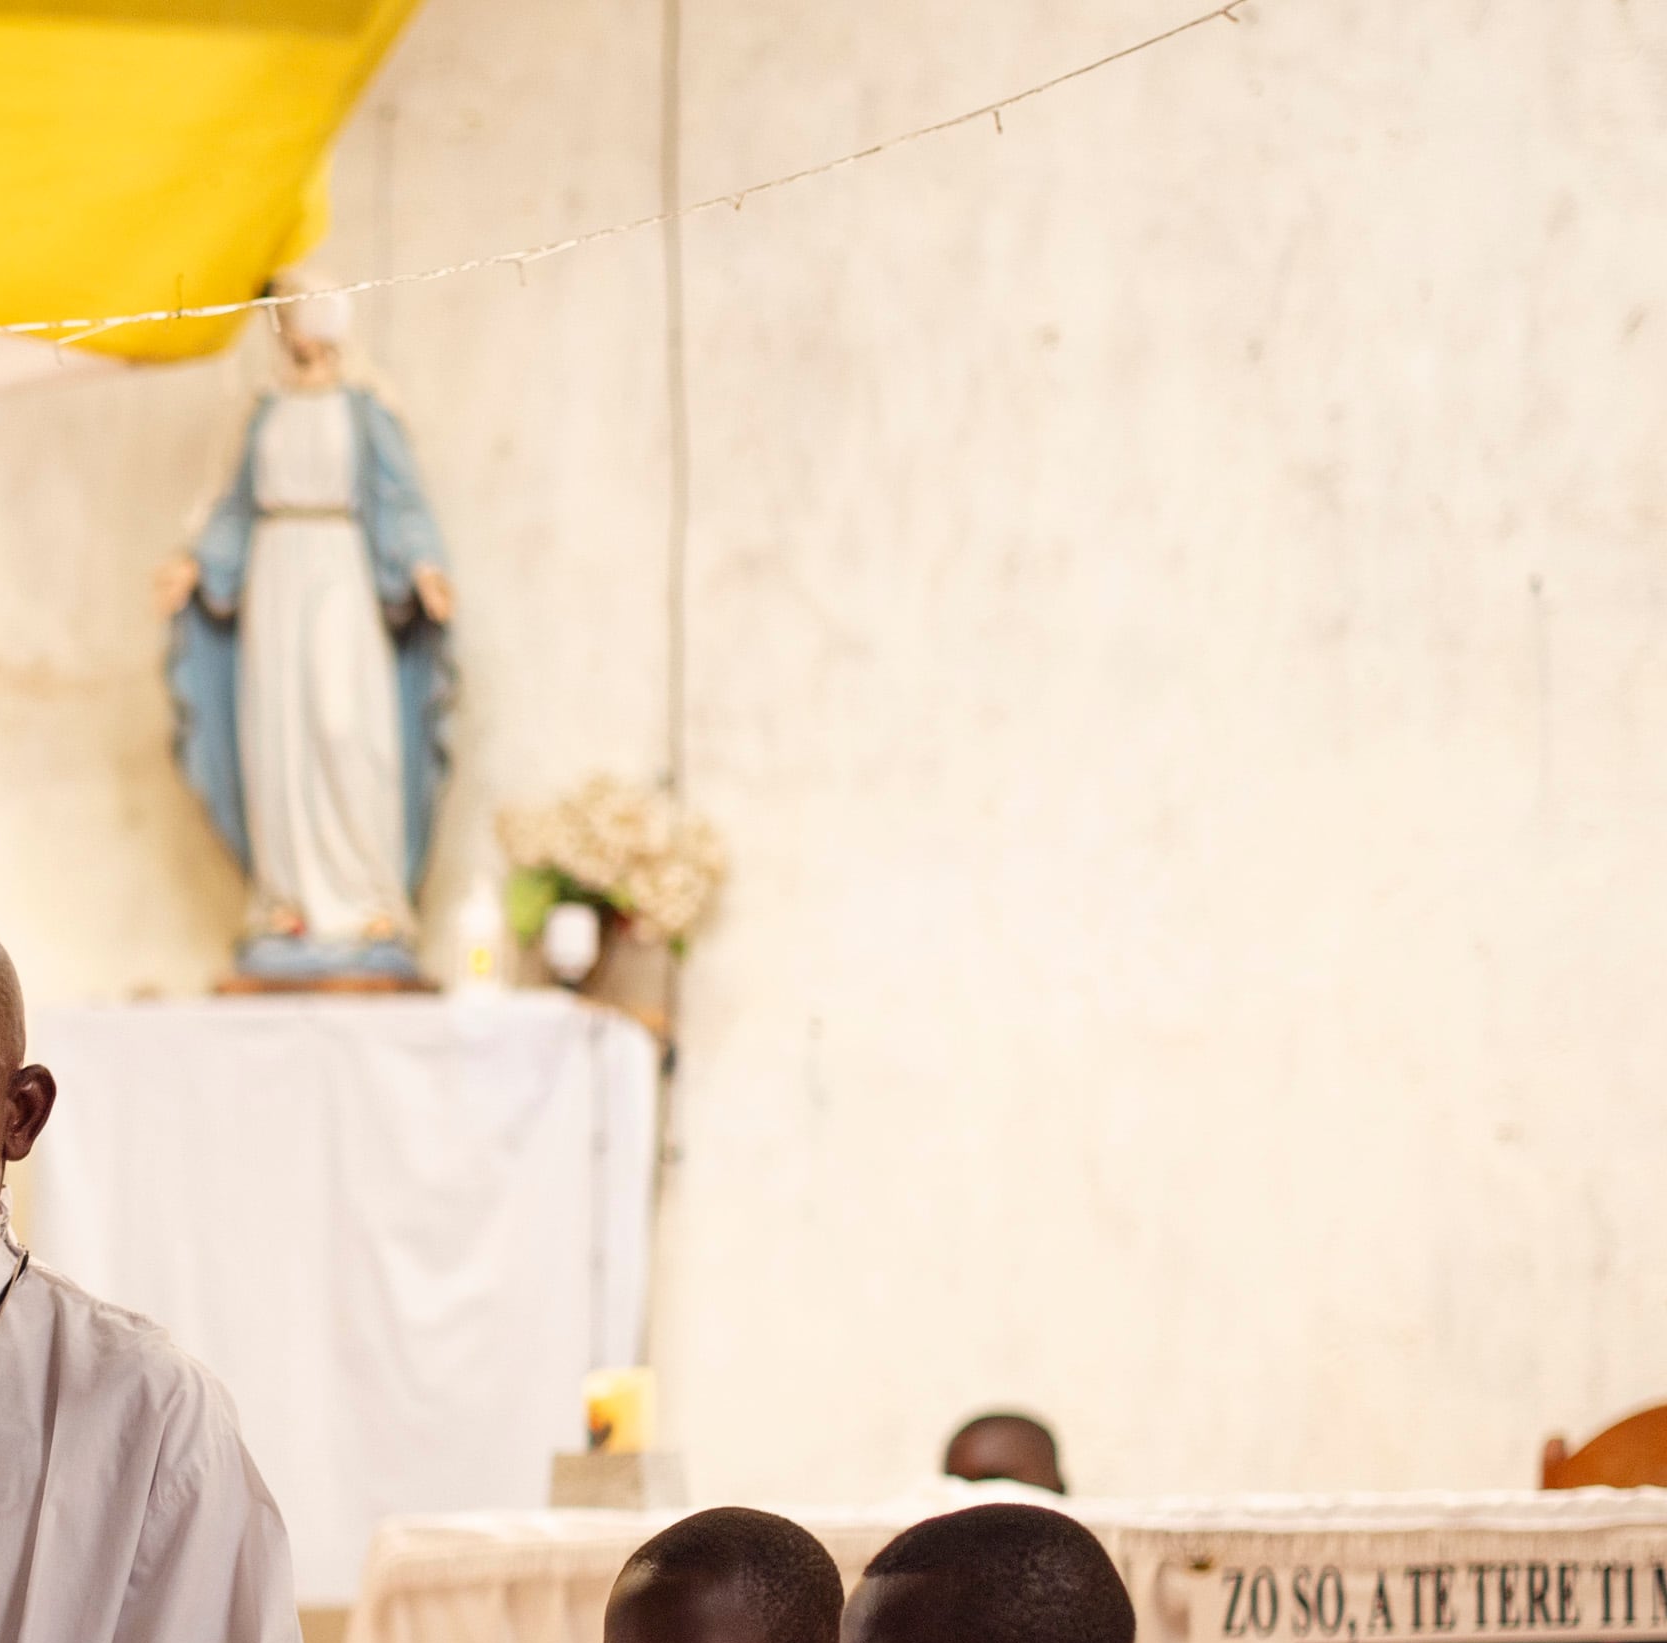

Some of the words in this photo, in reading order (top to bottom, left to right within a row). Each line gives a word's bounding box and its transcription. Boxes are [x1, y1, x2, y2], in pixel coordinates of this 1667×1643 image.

[1221, 1567, 1279, 1637] ZO
[1369, 1569, 1395, 1634] A
[1468, 1562, 1580, 1630] TERE
[1593, 1561, 1635, 1626] TI
